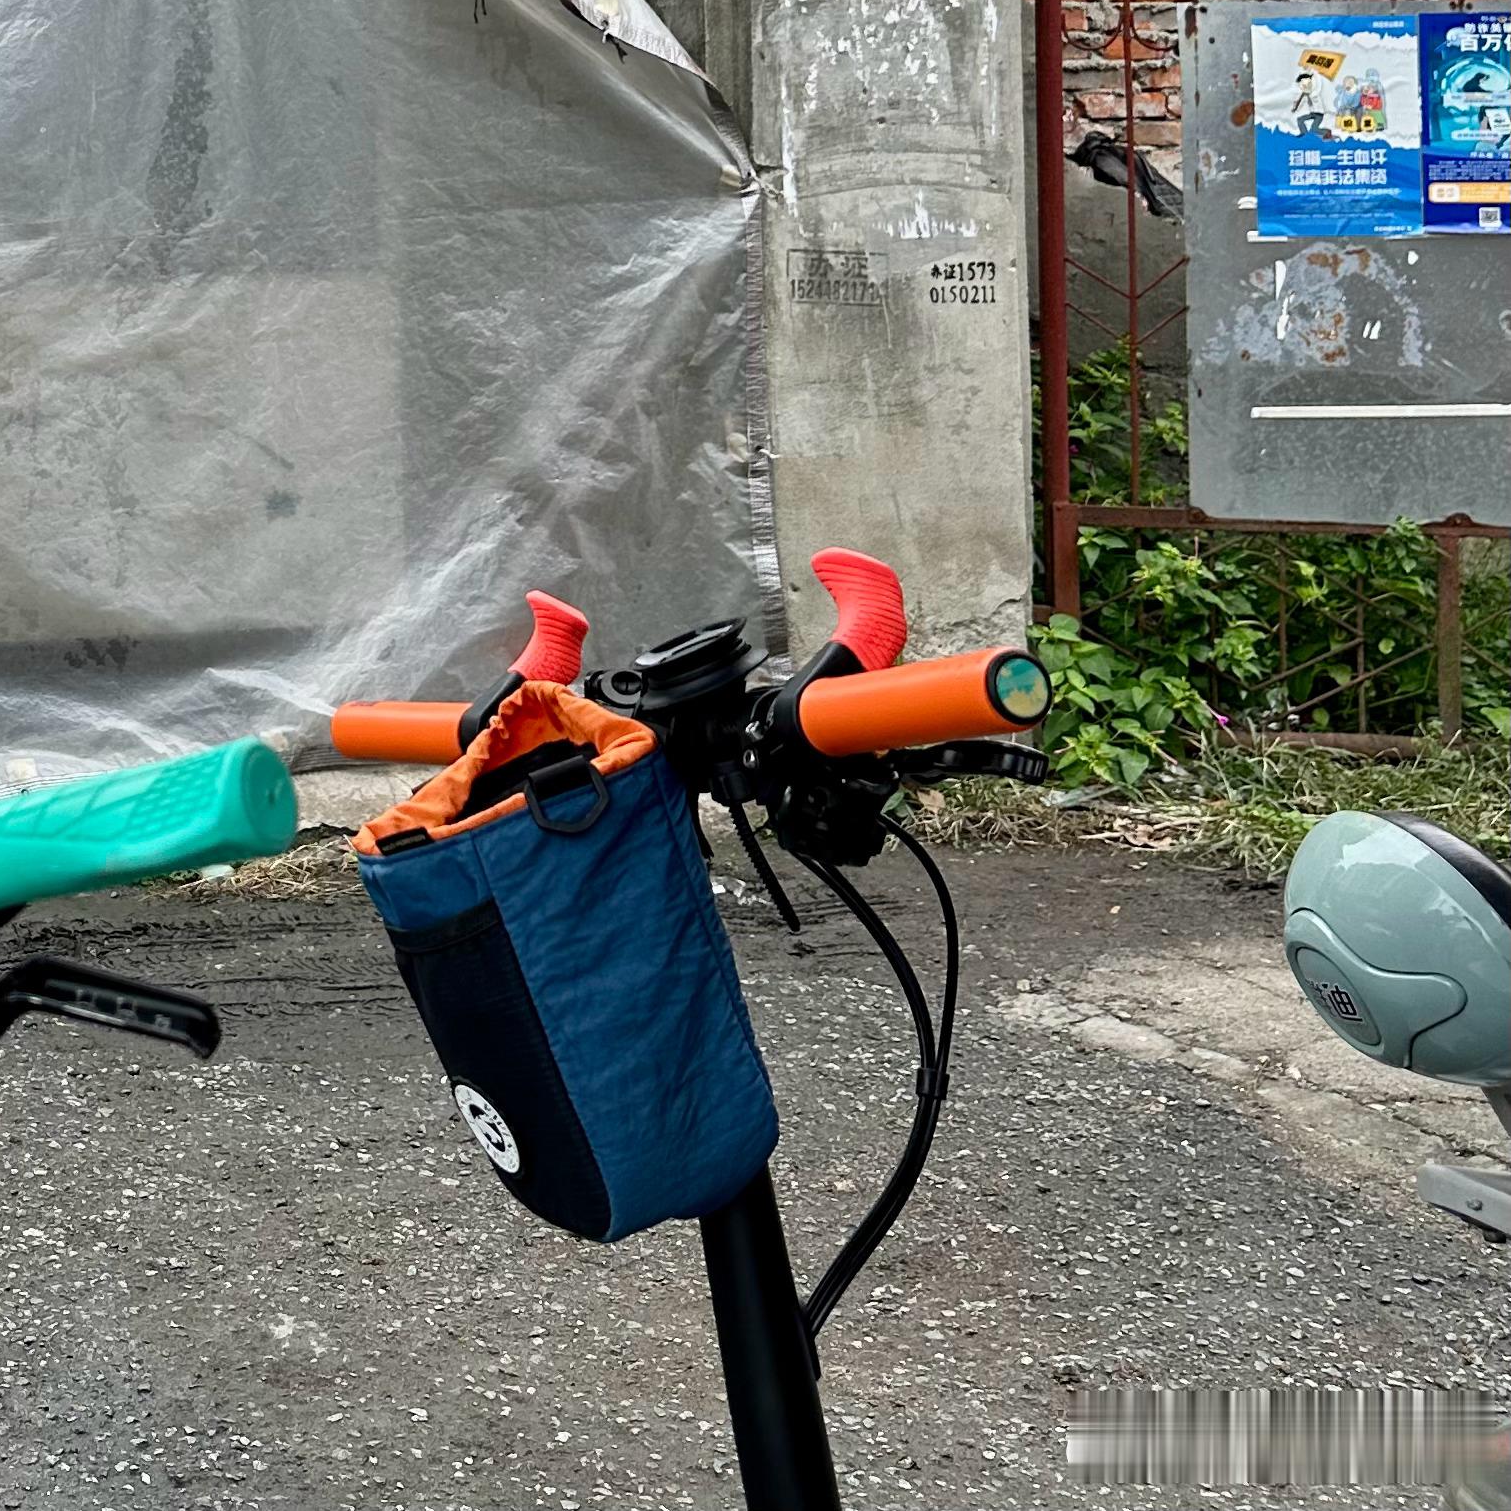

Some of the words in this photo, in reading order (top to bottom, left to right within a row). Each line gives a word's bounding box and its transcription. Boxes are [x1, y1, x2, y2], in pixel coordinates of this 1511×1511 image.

[1288, 149, 1387, 166] 珍惜一生血汗
[1289, 168, 1387, 186] 远离非法集资
[930, 285, 997, 304] 0150211
